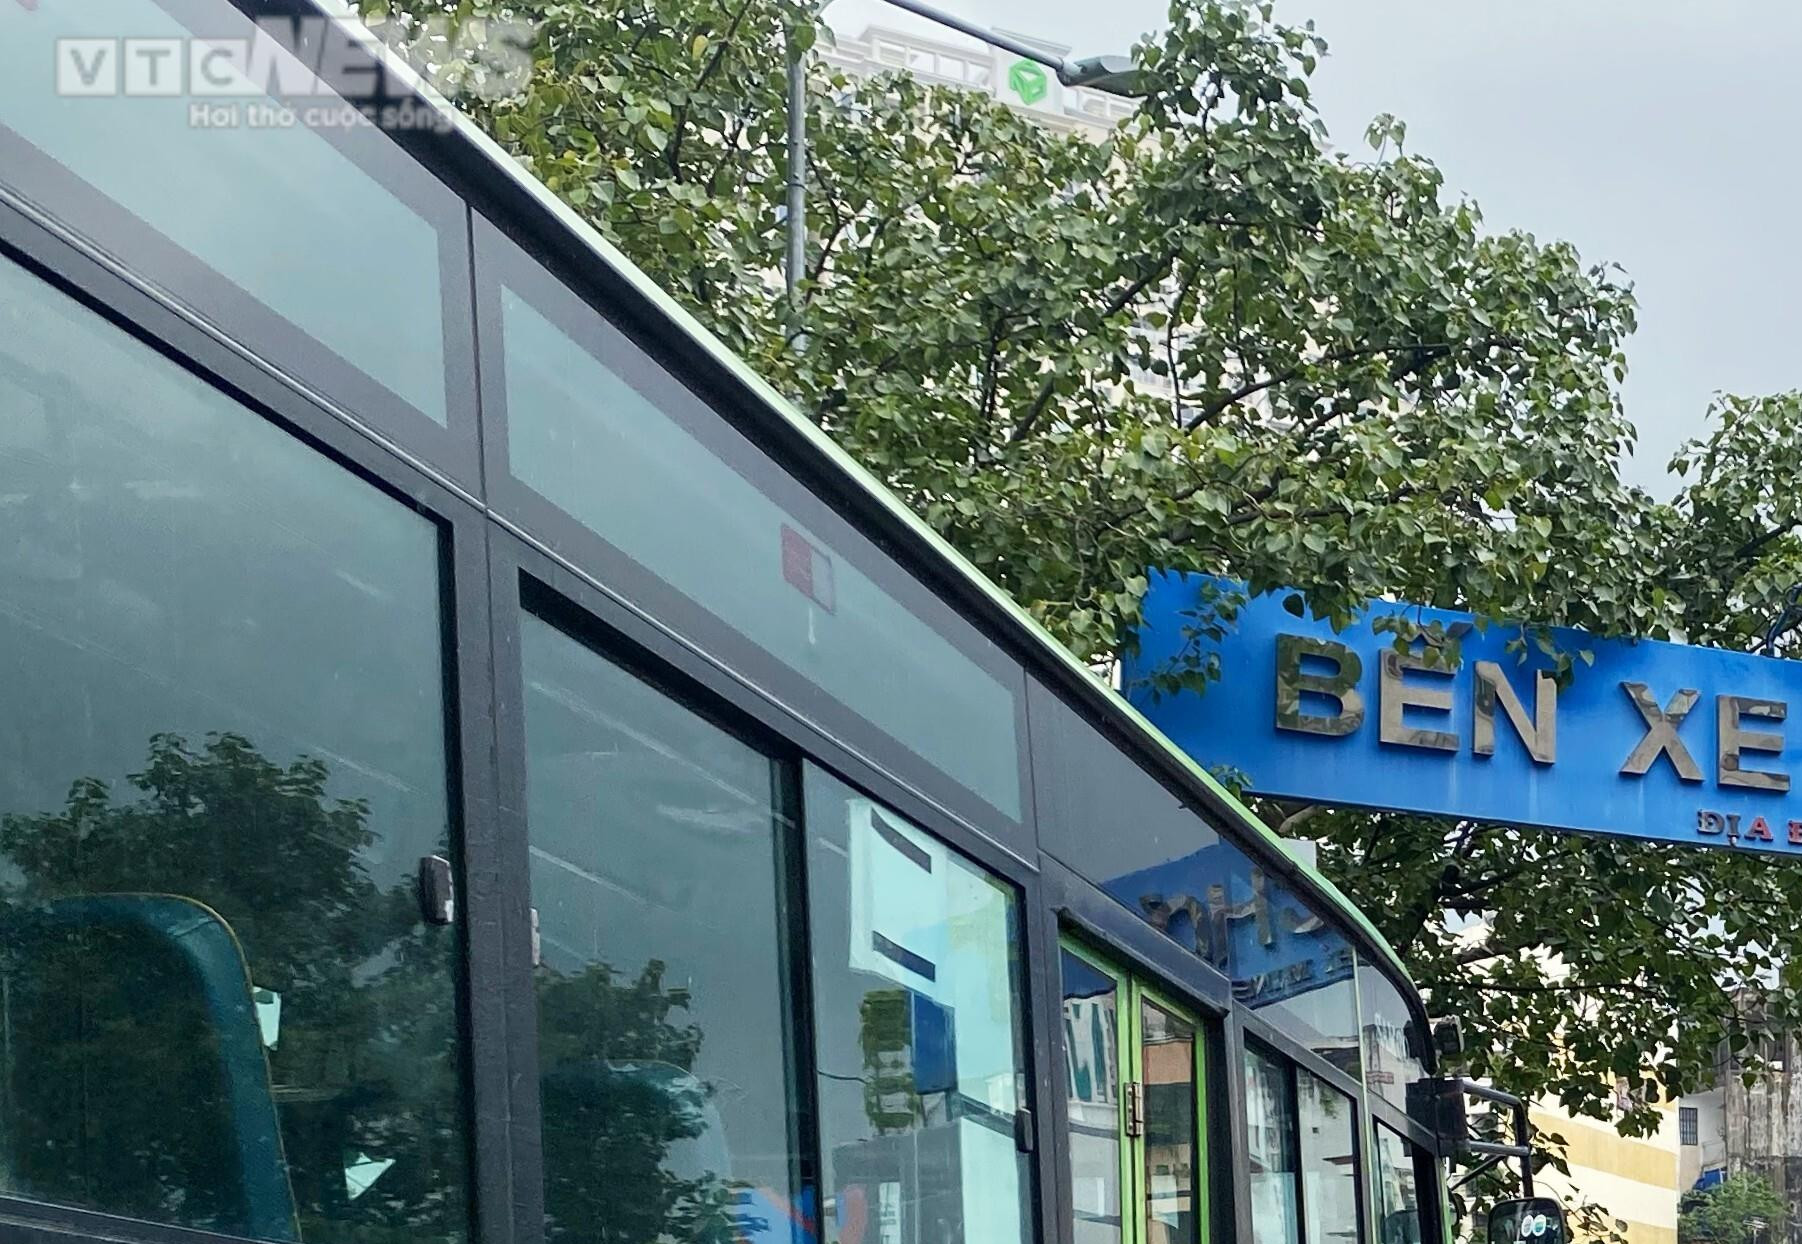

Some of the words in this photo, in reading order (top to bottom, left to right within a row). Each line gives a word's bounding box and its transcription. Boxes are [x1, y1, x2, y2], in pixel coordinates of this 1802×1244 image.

[1277, 621, 1558, 764] BẾN
[1619, 680, 1792, 792] XE
[1697, 809, 1773, 847] ĐỊA
